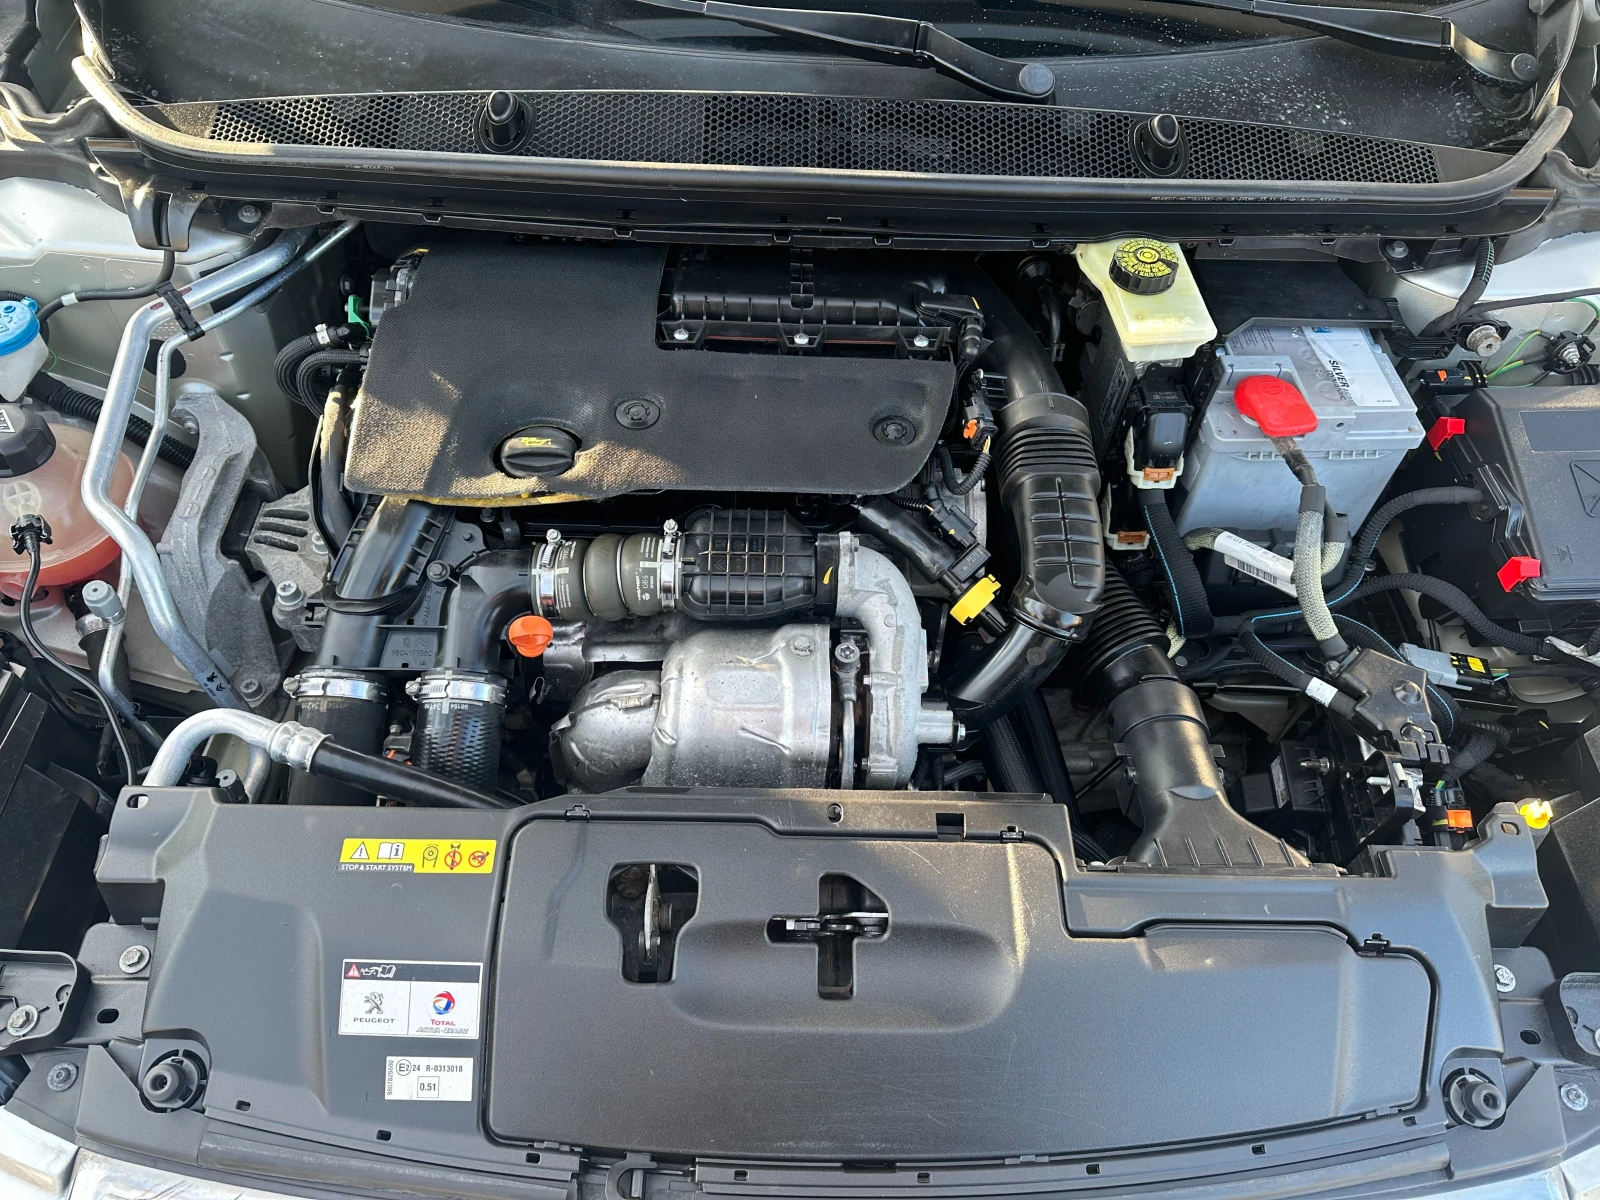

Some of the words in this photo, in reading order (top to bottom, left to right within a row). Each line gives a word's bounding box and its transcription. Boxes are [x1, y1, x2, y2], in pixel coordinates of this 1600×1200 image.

[1328, 359, 1350, 389] SILVER
[340, 863, 359, 871] STOP
[430, 1018, 456, 1026] TOTAL
[412, 1064, 421, 1072] 24
[425, 1064, 463, 1073] R-0313018
[419, 1082, 436, 1092] 0.51
